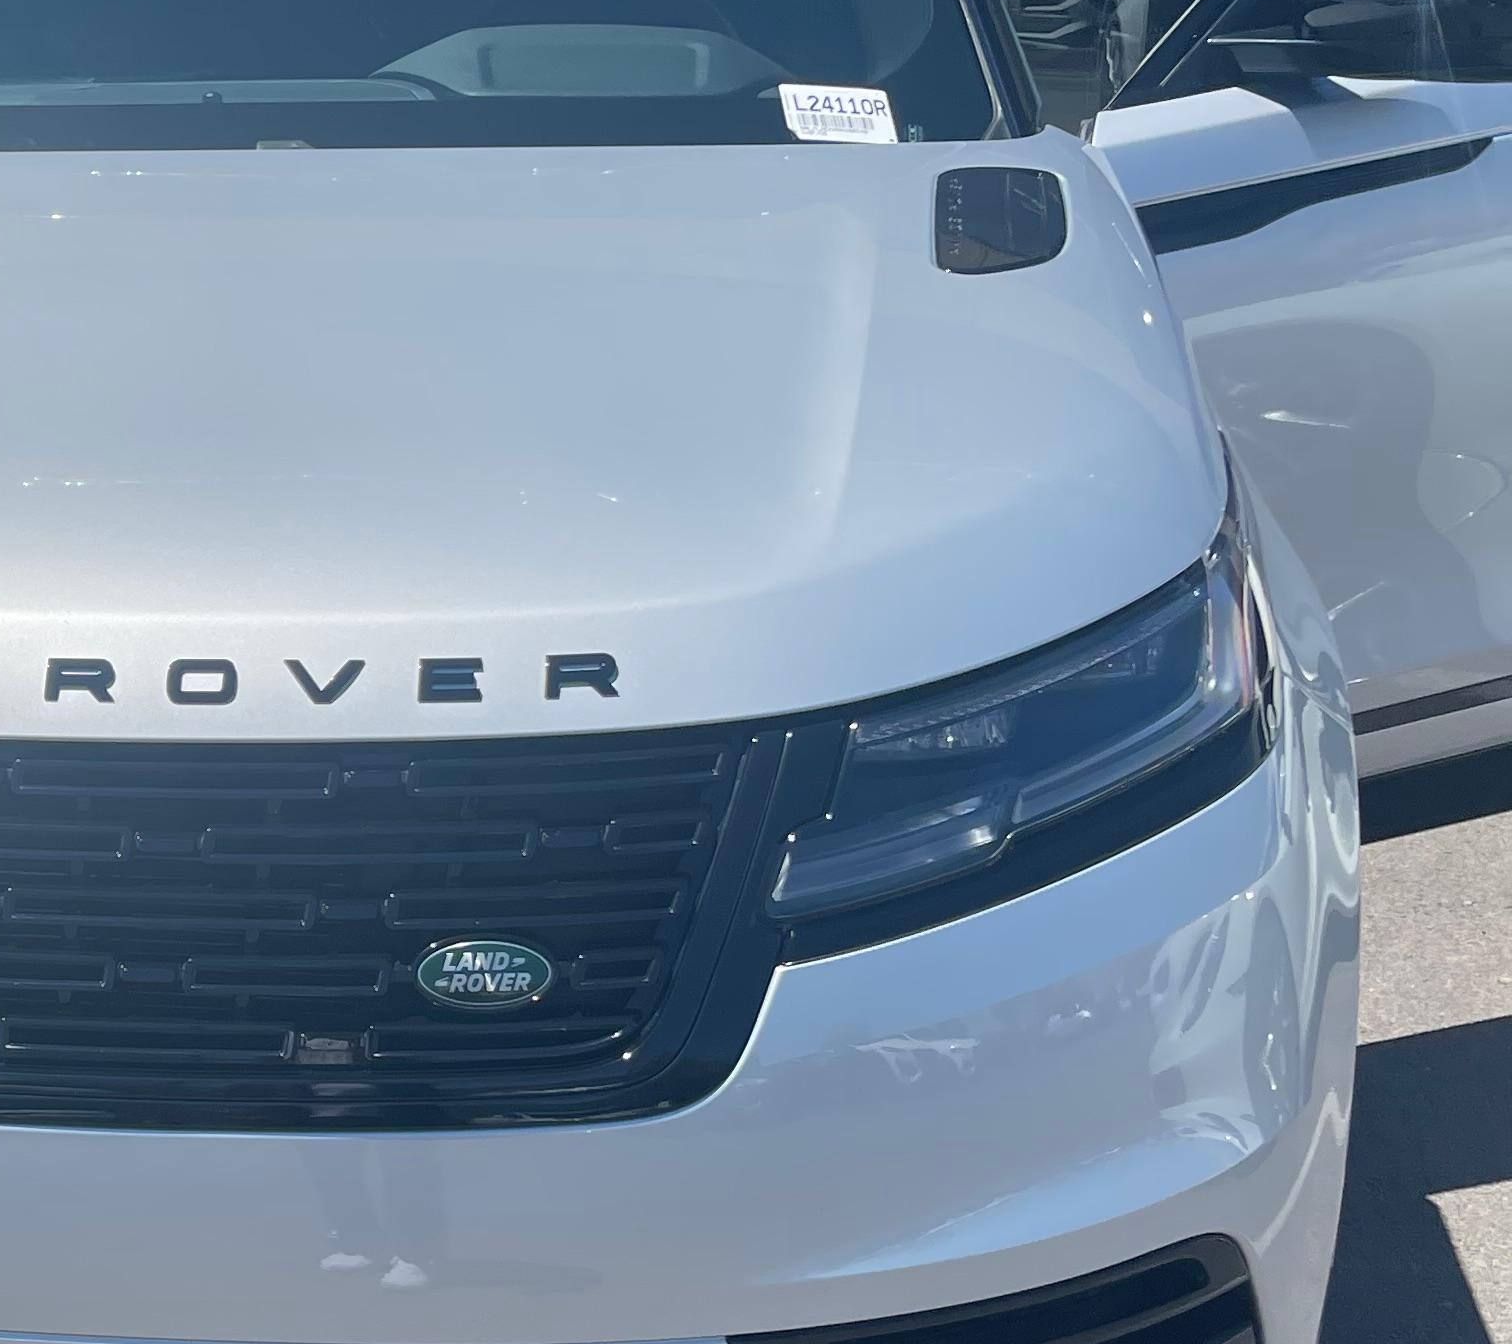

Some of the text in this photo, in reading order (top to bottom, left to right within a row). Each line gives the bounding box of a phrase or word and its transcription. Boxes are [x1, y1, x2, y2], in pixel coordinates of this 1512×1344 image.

[792, 93, 888, 117] L24110R
[43, 652, 621, 706] ROVER
[441, 951, 510, 972] LAND
[449, 972, 532, 993] ROVER
